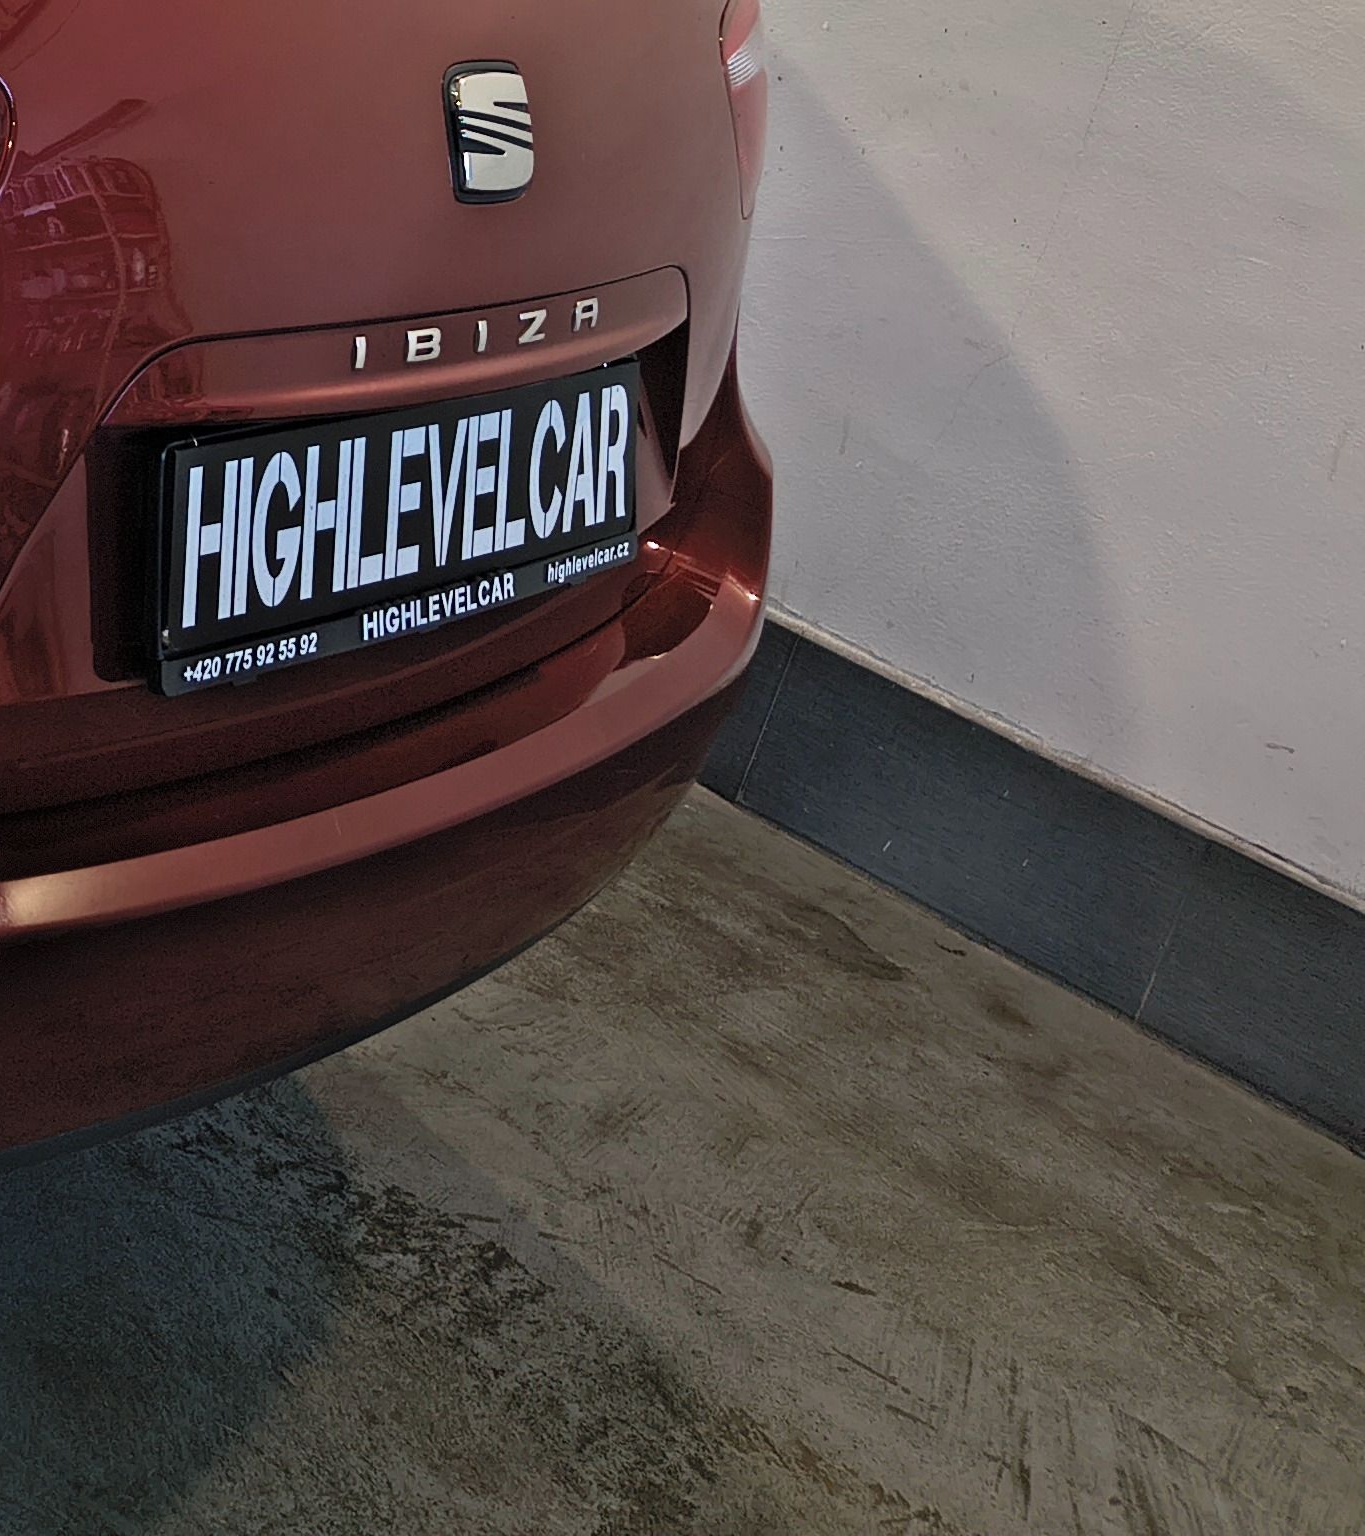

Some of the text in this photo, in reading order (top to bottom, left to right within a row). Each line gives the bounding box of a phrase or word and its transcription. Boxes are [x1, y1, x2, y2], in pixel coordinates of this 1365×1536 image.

[352, 297, 599, 369] IBIZA
[182, 383, 629, 628] HIGHLEVELCAR
[547, 541, 630, 583] highlevelcar.cz
[363, 572, 515, 641] HIGHLEVELCAR
[184, 632, 318, 682] +420 775 92 55 92
